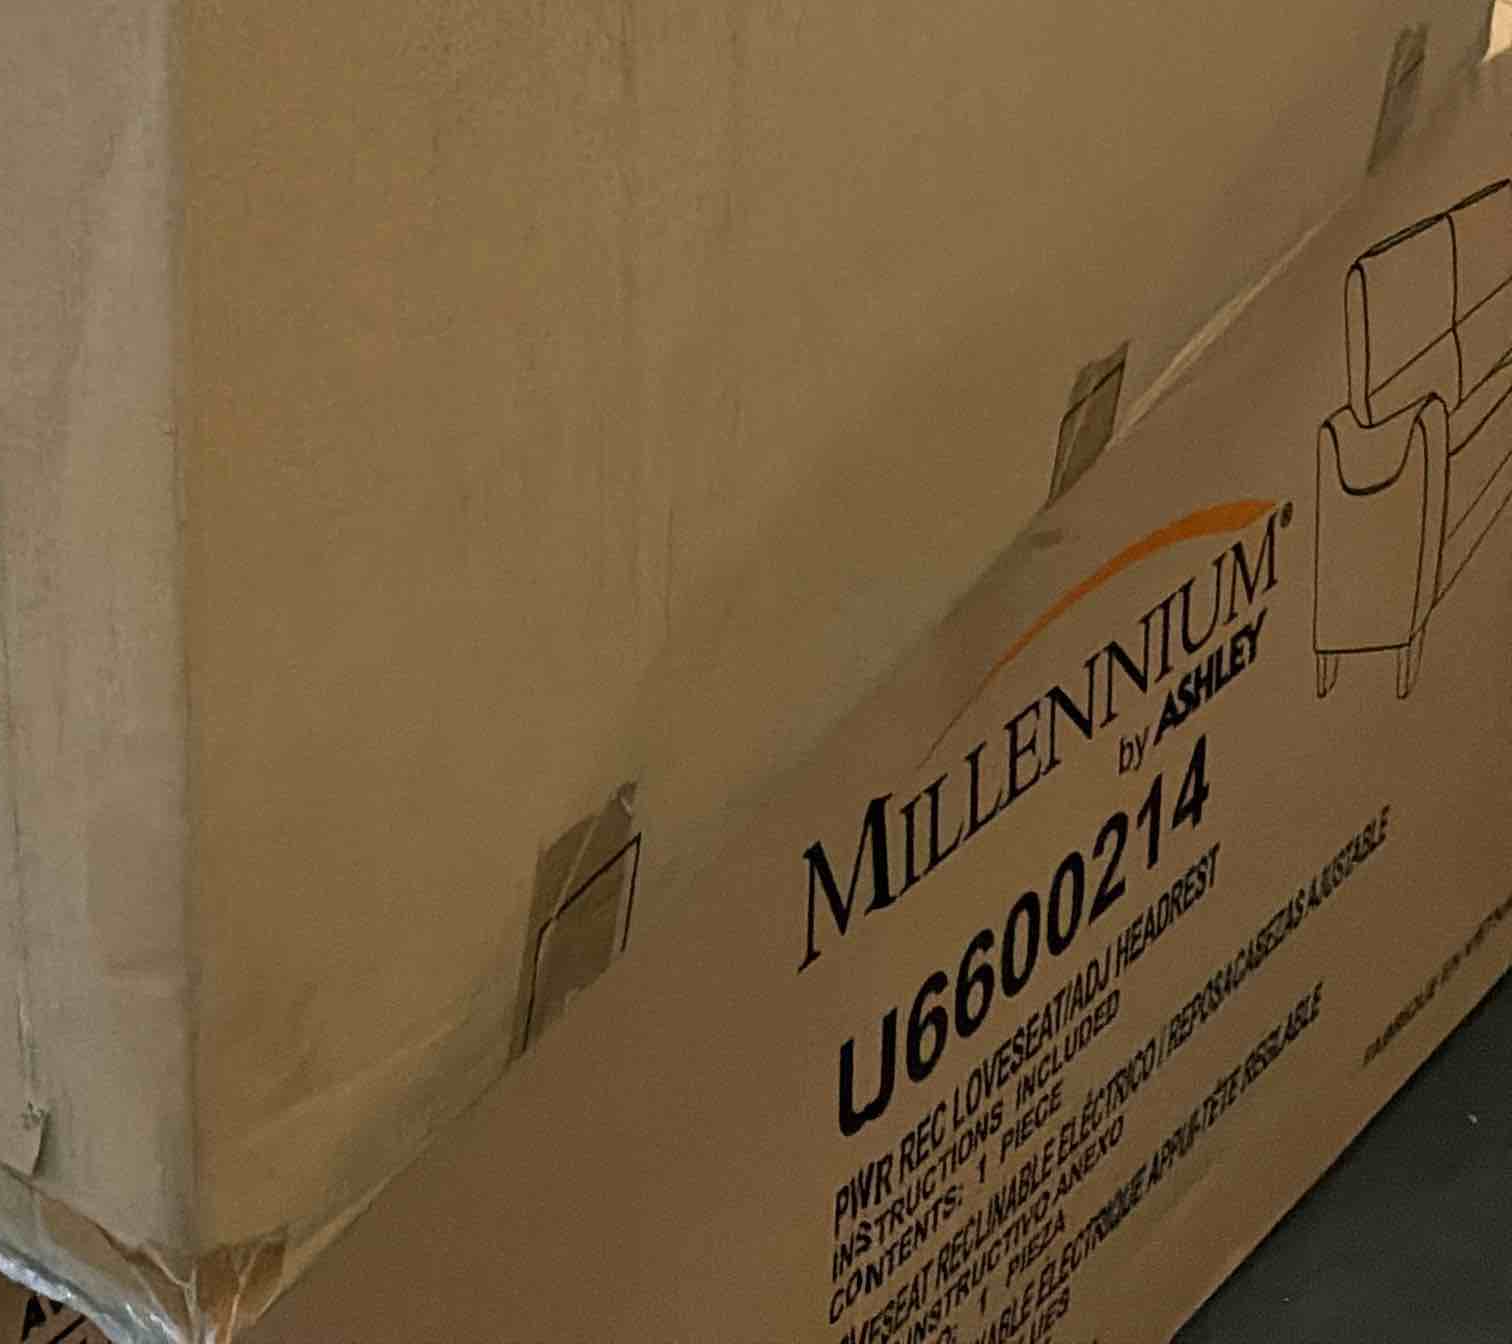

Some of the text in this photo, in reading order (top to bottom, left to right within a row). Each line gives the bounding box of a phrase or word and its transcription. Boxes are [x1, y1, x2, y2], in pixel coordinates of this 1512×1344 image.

[1118, 608, 1268, 776] by ASHLEY
[838, 734, 1211, 1137] U6600214
[831, 989, 1120, 1284] INSTRUCTIONS INCLUDED
[834, 841, 1220, 1239] PWR REC LOVESEAT/ADJ HEADREST
[828, 1182, 964, 1326] CONTENTS:
[999, 1079, 1064, 1164] PIECE
[935, 1136, 1058, 1292] RECLINABLE
[1005, 1207, 1066, 1289] PIEZA
[1052, 1113, 1126, 1206] ANEXO
